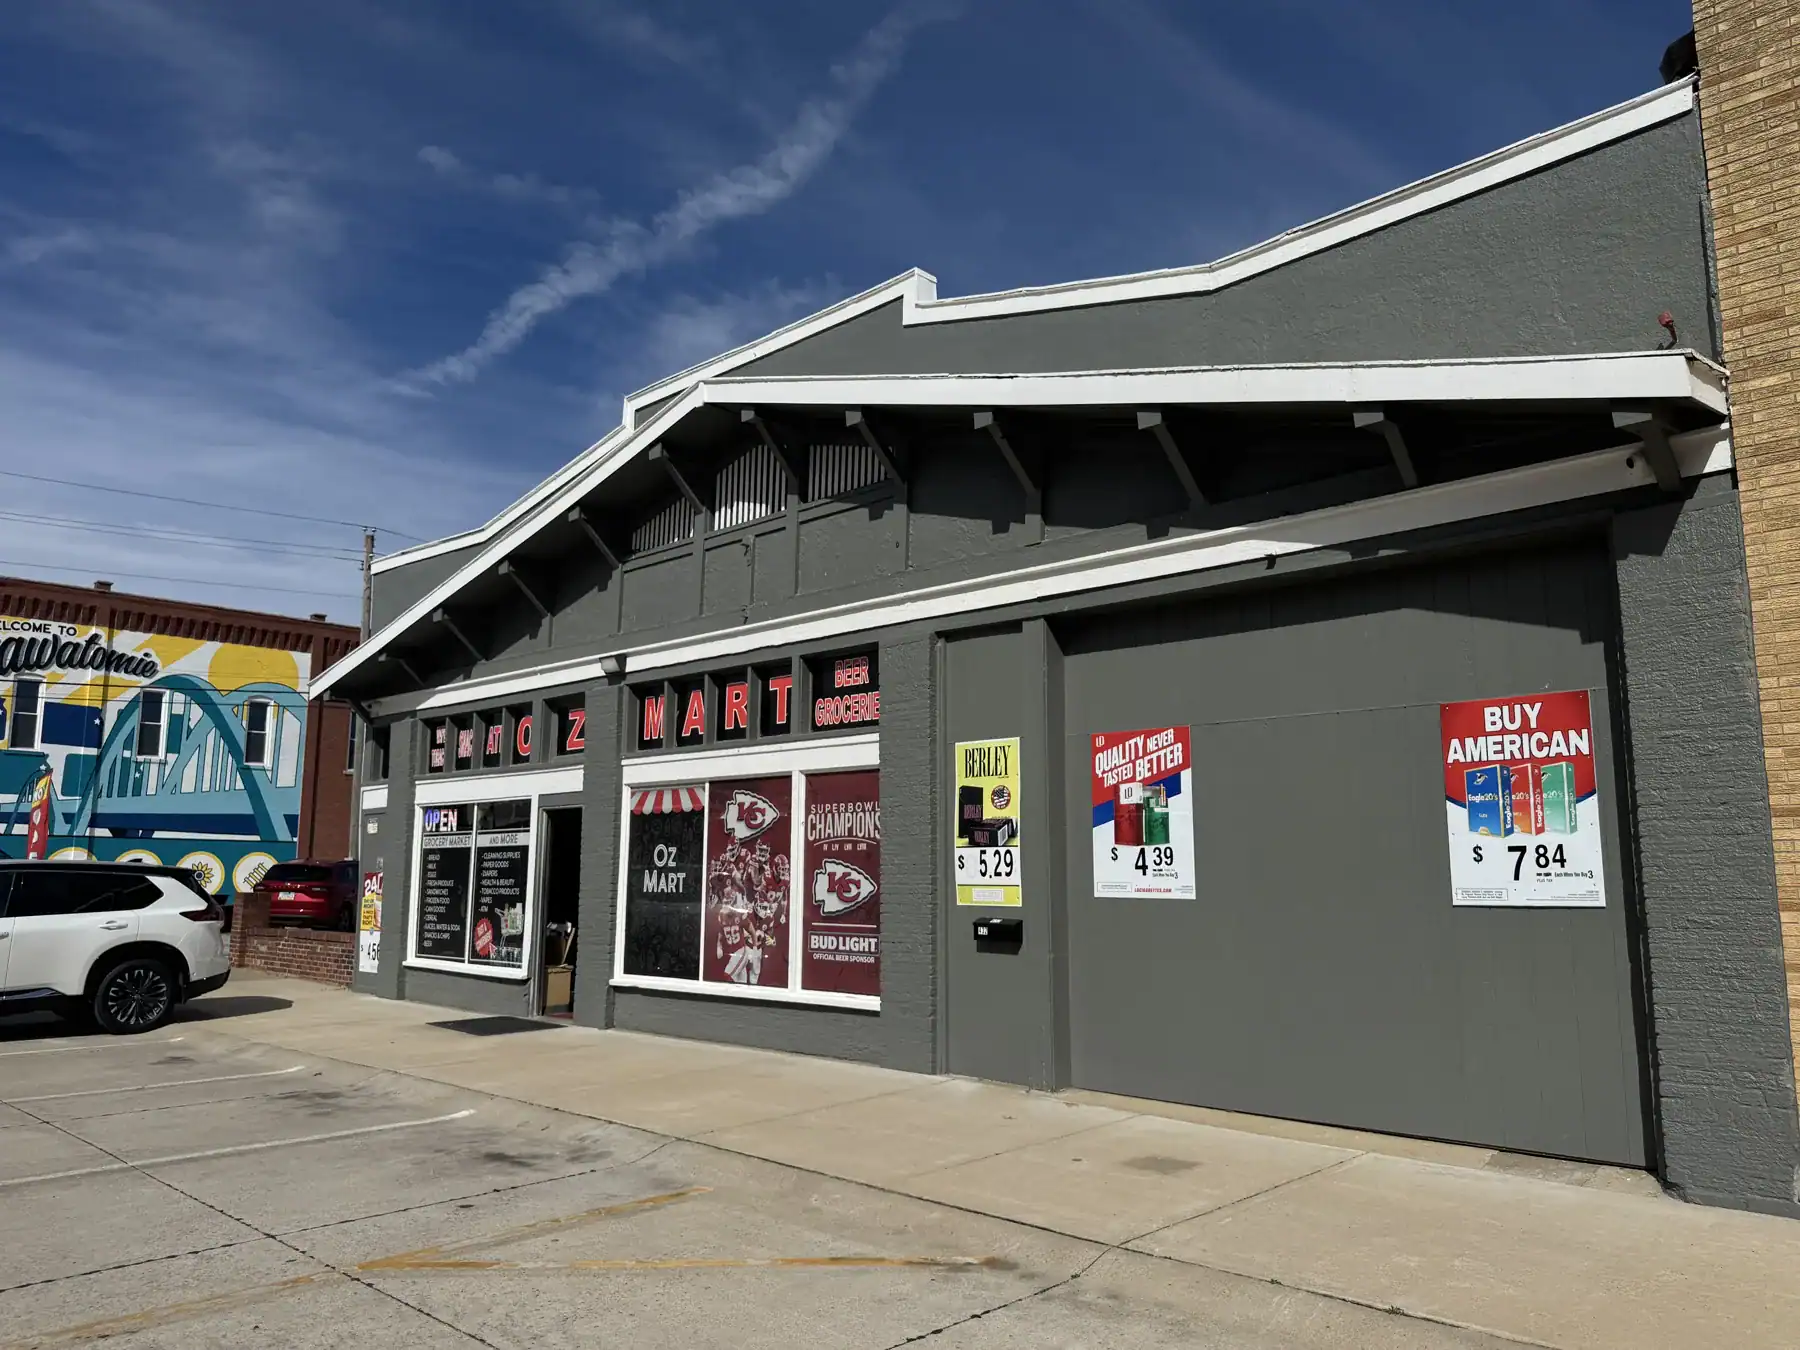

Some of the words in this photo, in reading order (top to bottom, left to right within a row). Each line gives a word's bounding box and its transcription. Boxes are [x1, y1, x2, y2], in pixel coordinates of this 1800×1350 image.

[0, 620, 52, 634] LCOME
[58, 625, 78, 637] TO
[0, 632, 160, 678] awatomie
[835, 655, 870, 688] BEER
[814, 691, 881, 727] GROCERIE
[1483, 702, 1544, 734] BUY
[1095, 734, 1145, 779] QUALITY
[1147, 728, 1175, 754] NEVER
[1446, 728, 1590, 765] AMERICAN
[964, 745, 1012, 779] BERLEY
[1102, 763, 1134, 788] TASTED
[1135, 742, 1183, 782] BETTER
[1543, 790, 1564, 800] e20's
[810, 801, 881, 814] SUPERBOWL
[425, 808, 457, 832] OPEN
[807, 811, 881, 841] CHAMPIONS
[424, 836, 449, 847] GROCERY
[449, 835, 472, 847] MARKET
[489, 836, 499, 845] AND
[500, 834, 519, 845] MORE
[958, 854, 965, 871] $
[979, 848, 1014, 879] 5.29
[1111, 847, 1119, 862] $
[1472, 844, 1484, 865] $
[1587, 870, 1594, 879] 3
[810, 935, 837, 950] BUD
[838, 936, 878, 953] LIGHT
[813, 953, 835, 961] OFFICIAL
[836, 954, 849, 962] BEER
[849, 955, 875, 964] SPONSOR
